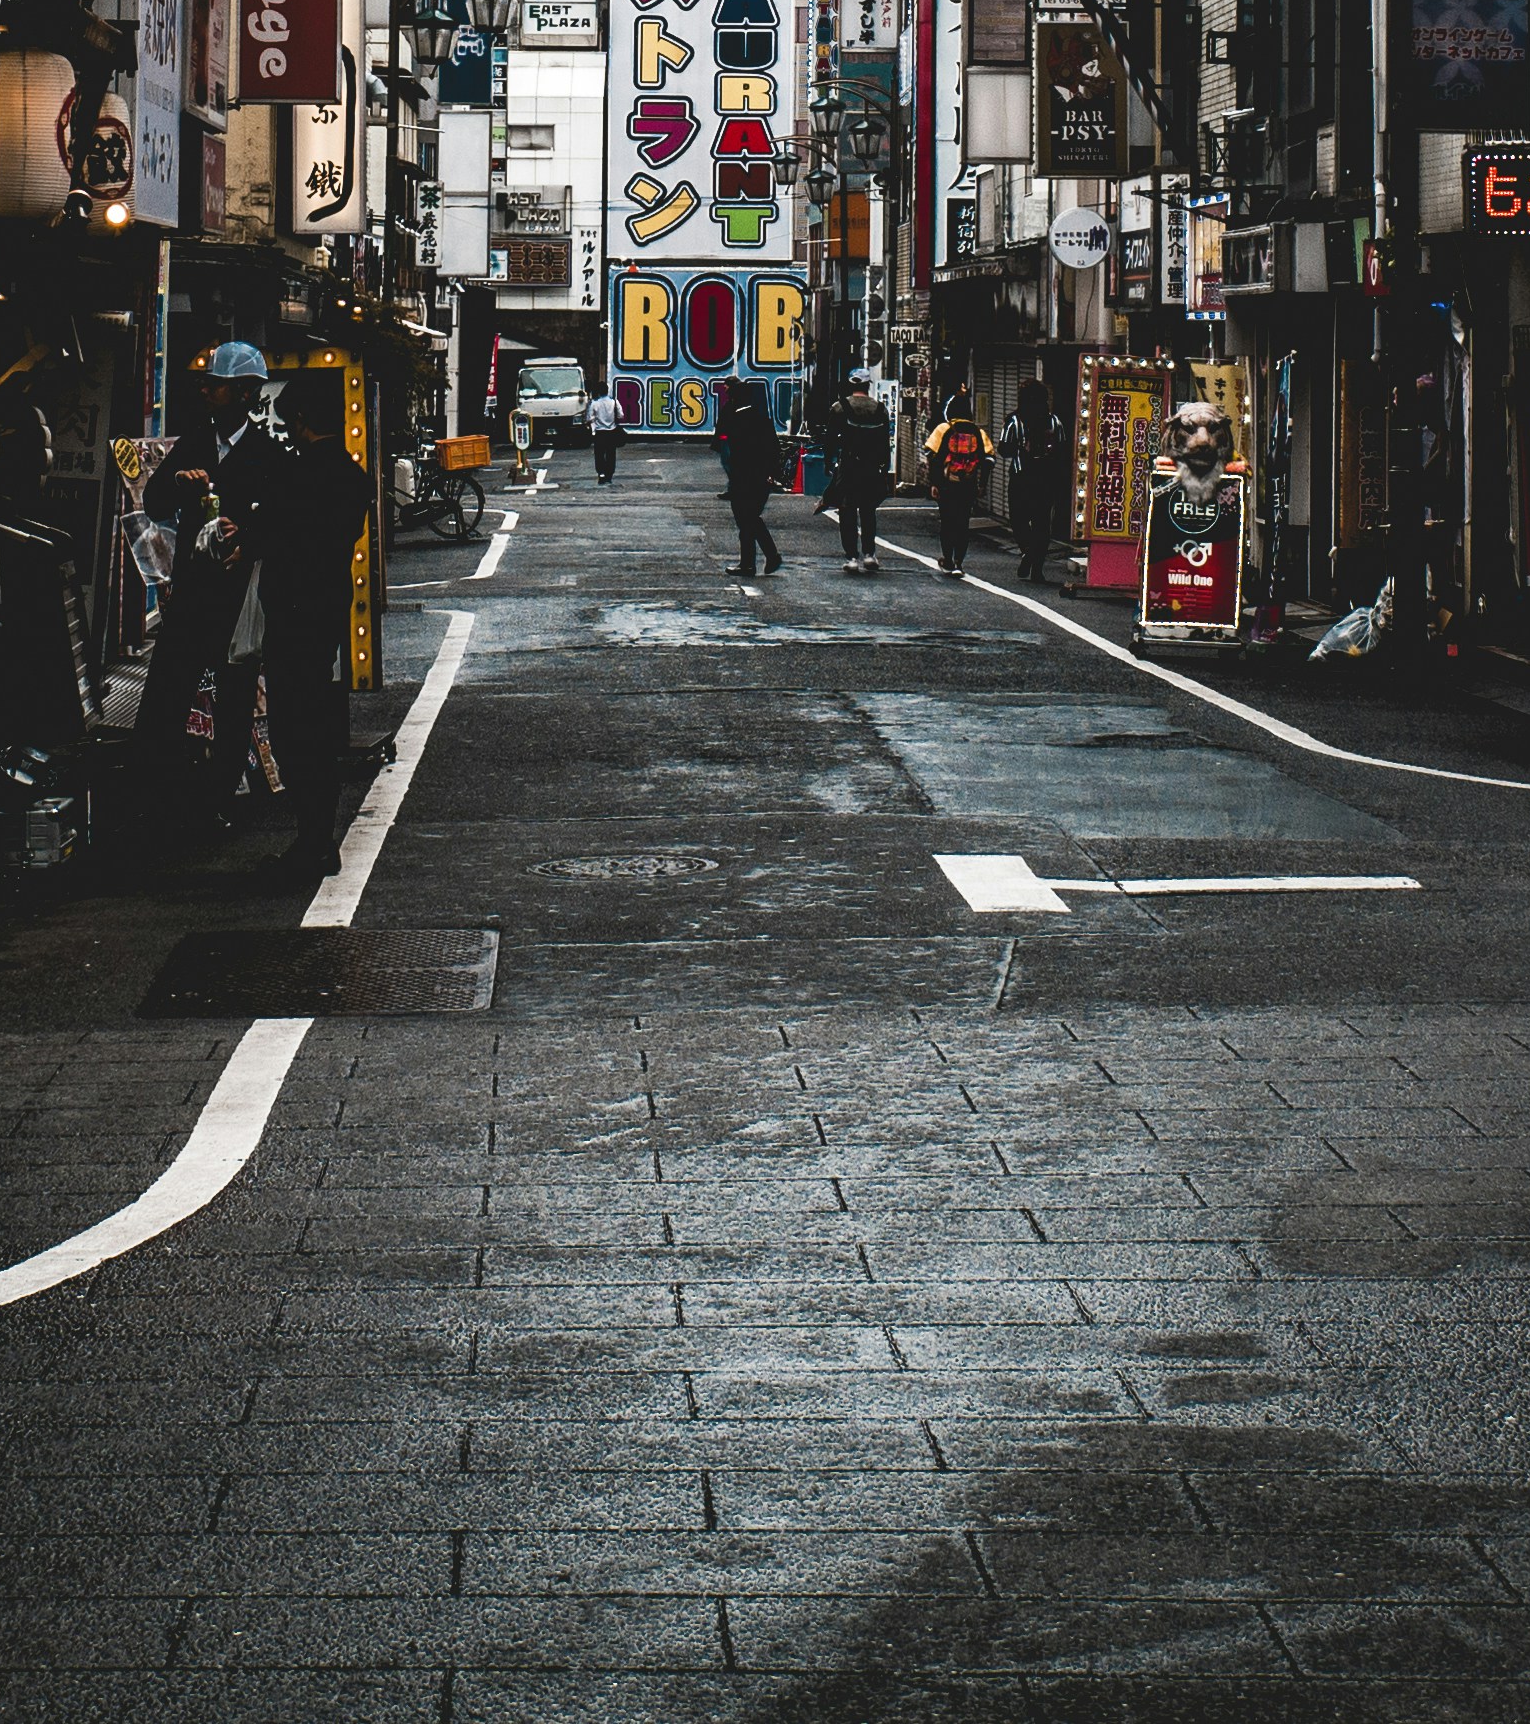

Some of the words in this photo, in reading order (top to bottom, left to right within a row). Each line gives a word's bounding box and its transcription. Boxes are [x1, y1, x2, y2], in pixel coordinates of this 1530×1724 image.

[529, 5, 572, 19] EAST
[537, 18, 591, 32] PLAZA
[1065, 109, 1104, 123] BAR
[495, 192, 541, 212] EAST
[581, 240, 596, 307] ルノアール
[890, 329, 912, 343] TACO
[1095, 392, 1130, 531] 無料情報館
[1168, 573, 1192, 586] Wild
